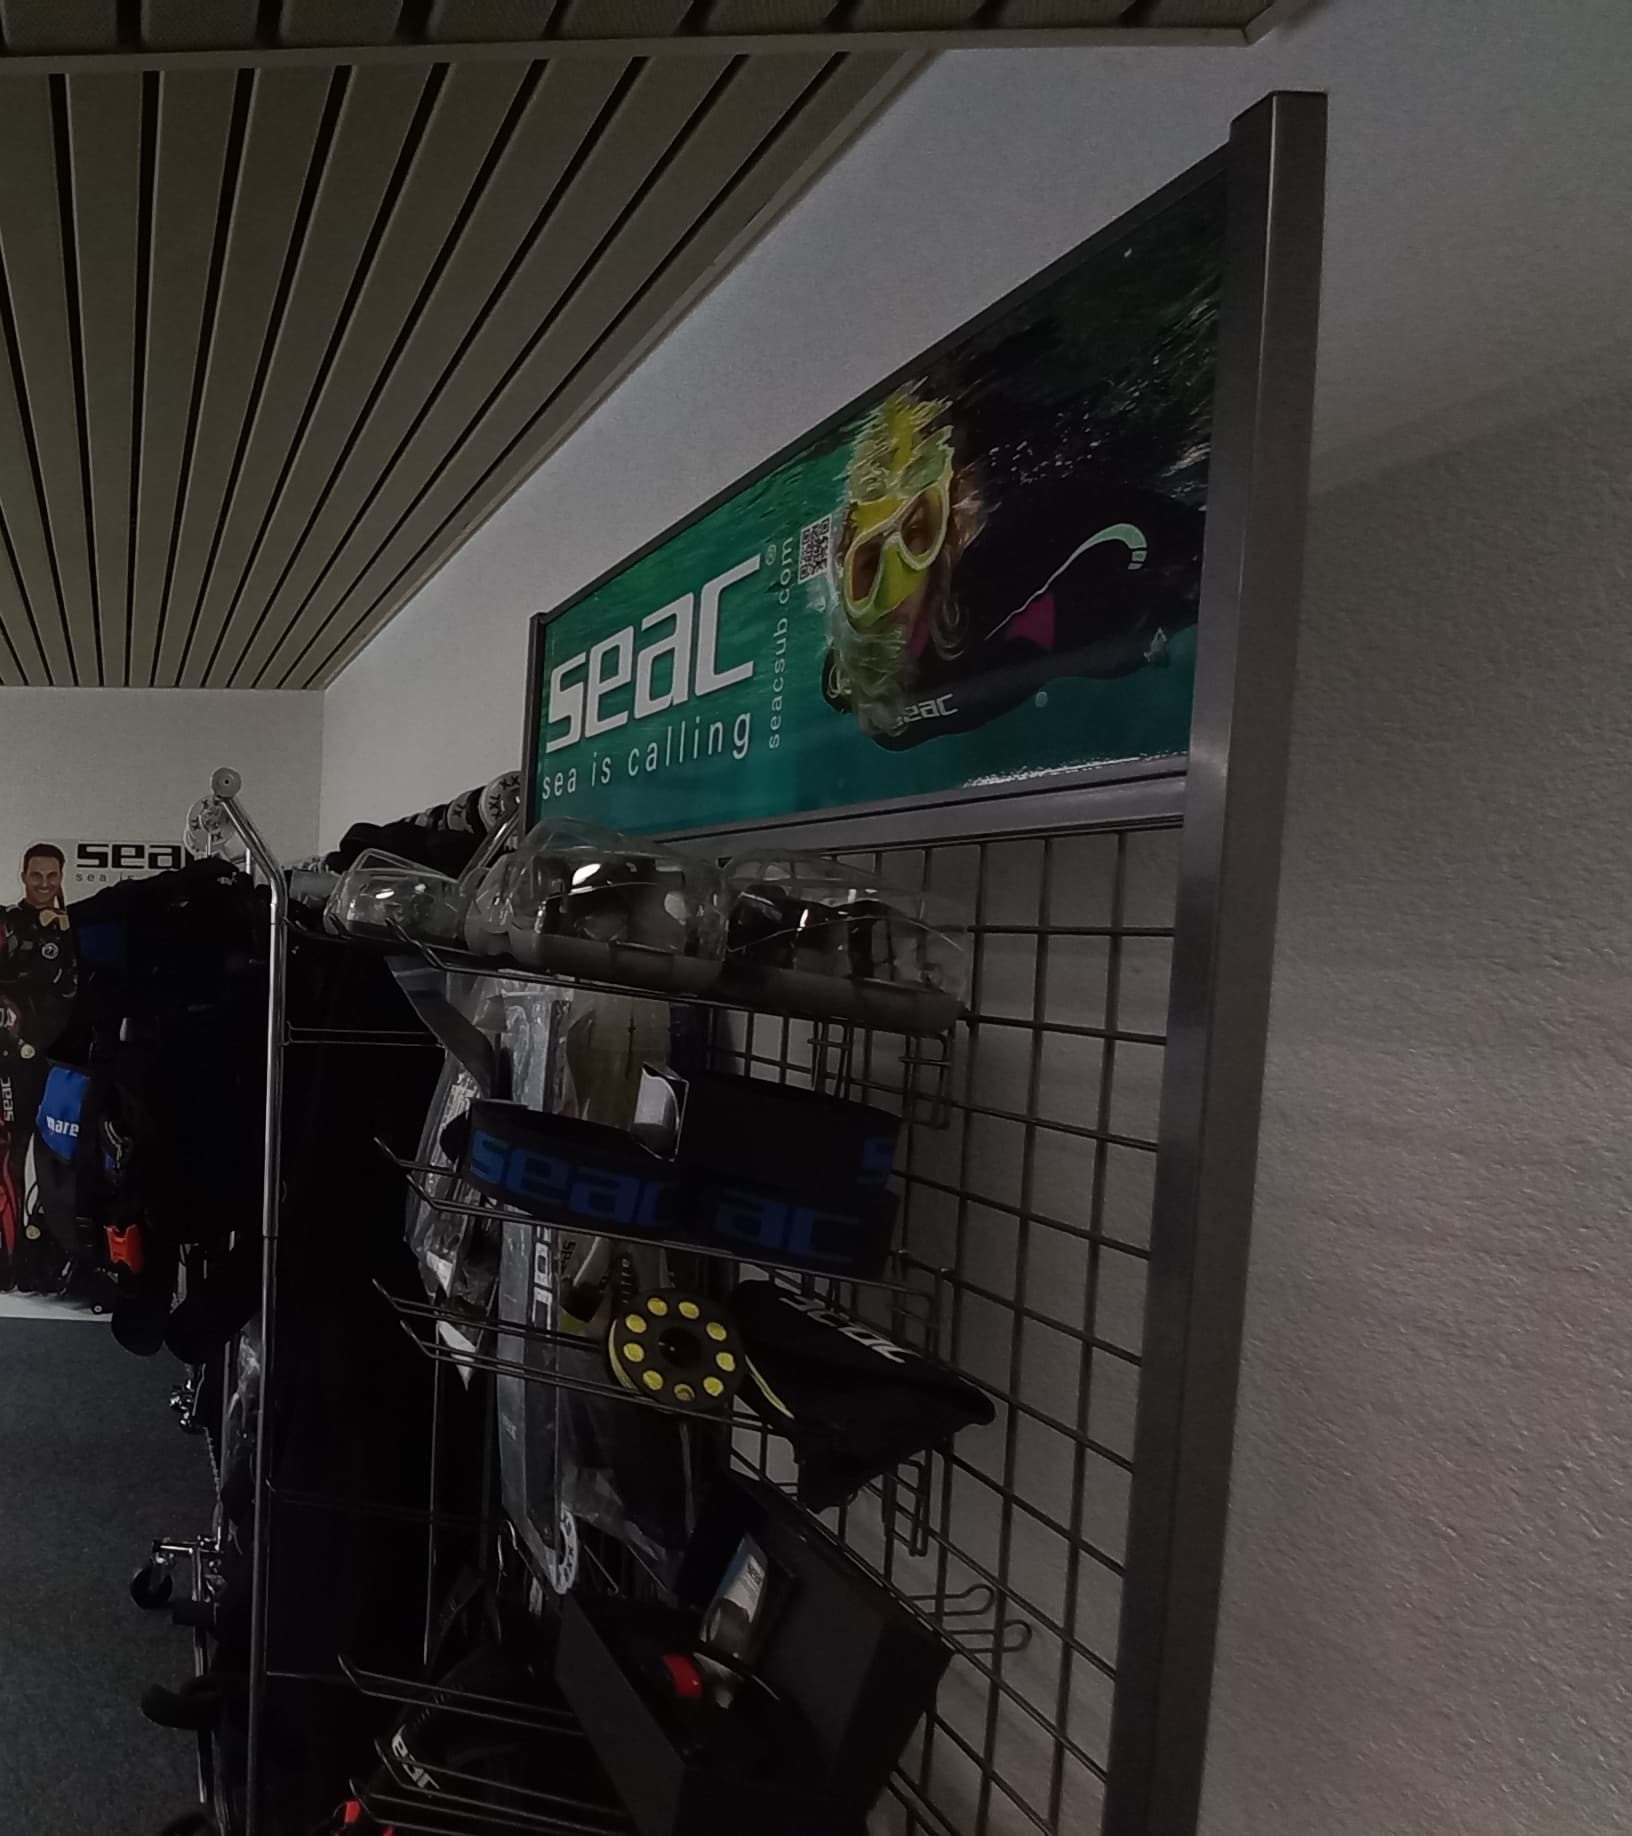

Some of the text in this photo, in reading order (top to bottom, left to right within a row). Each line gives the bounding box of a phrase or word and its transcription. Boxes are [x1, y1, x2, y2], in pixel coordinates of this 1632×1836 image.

[545, 552, 762, 754] seac
[541, 711, 752, 801] sea is calling
[76, 844, 189, 869] sea
